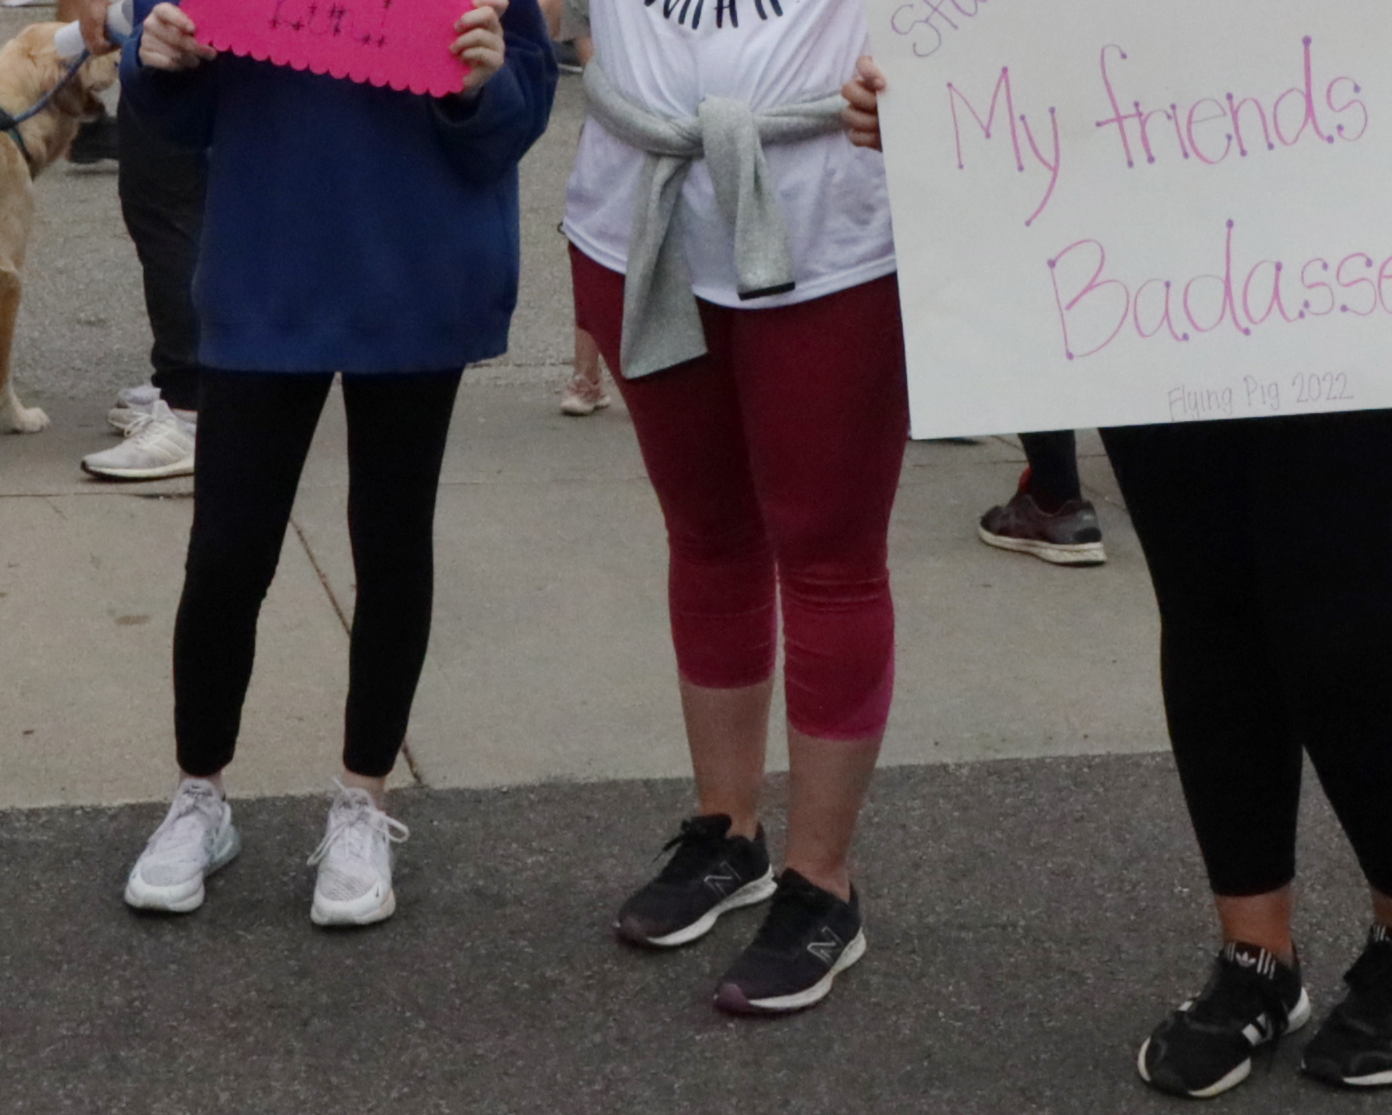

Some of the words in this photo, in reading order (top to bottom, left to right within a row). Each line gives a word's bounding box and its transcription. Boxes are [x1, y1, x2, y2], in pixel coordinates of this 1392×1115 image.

[945, 65, 1060, 228] My
[1095, 34, 1368, 168] friends
[1167, 384, 1233, 422] Flying
[1243, 373, 1280, 411] Pig
[1292, 371, 1355, 404] 2022
